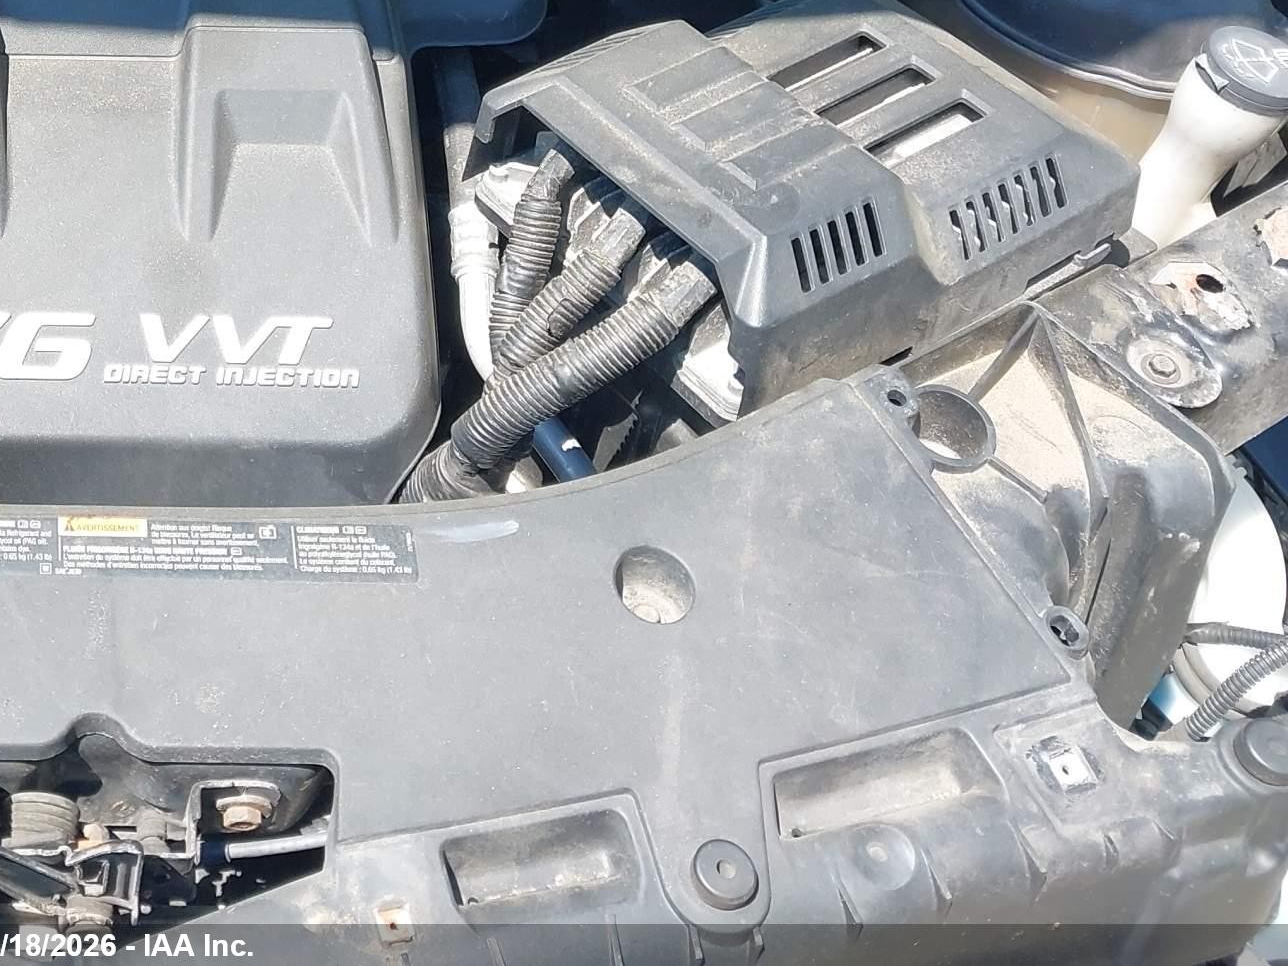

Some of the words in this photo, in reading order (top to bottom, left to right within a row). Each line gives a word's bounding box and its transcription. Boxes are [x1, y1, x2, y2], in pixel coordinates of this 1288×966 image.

[139, 313, 335, 366] VVT
[103, 363, 207, 386] DIRECT
[215, 366, 361, 389] INJECTION
[77, 523, 138, 532] AVERTISSEMENT
